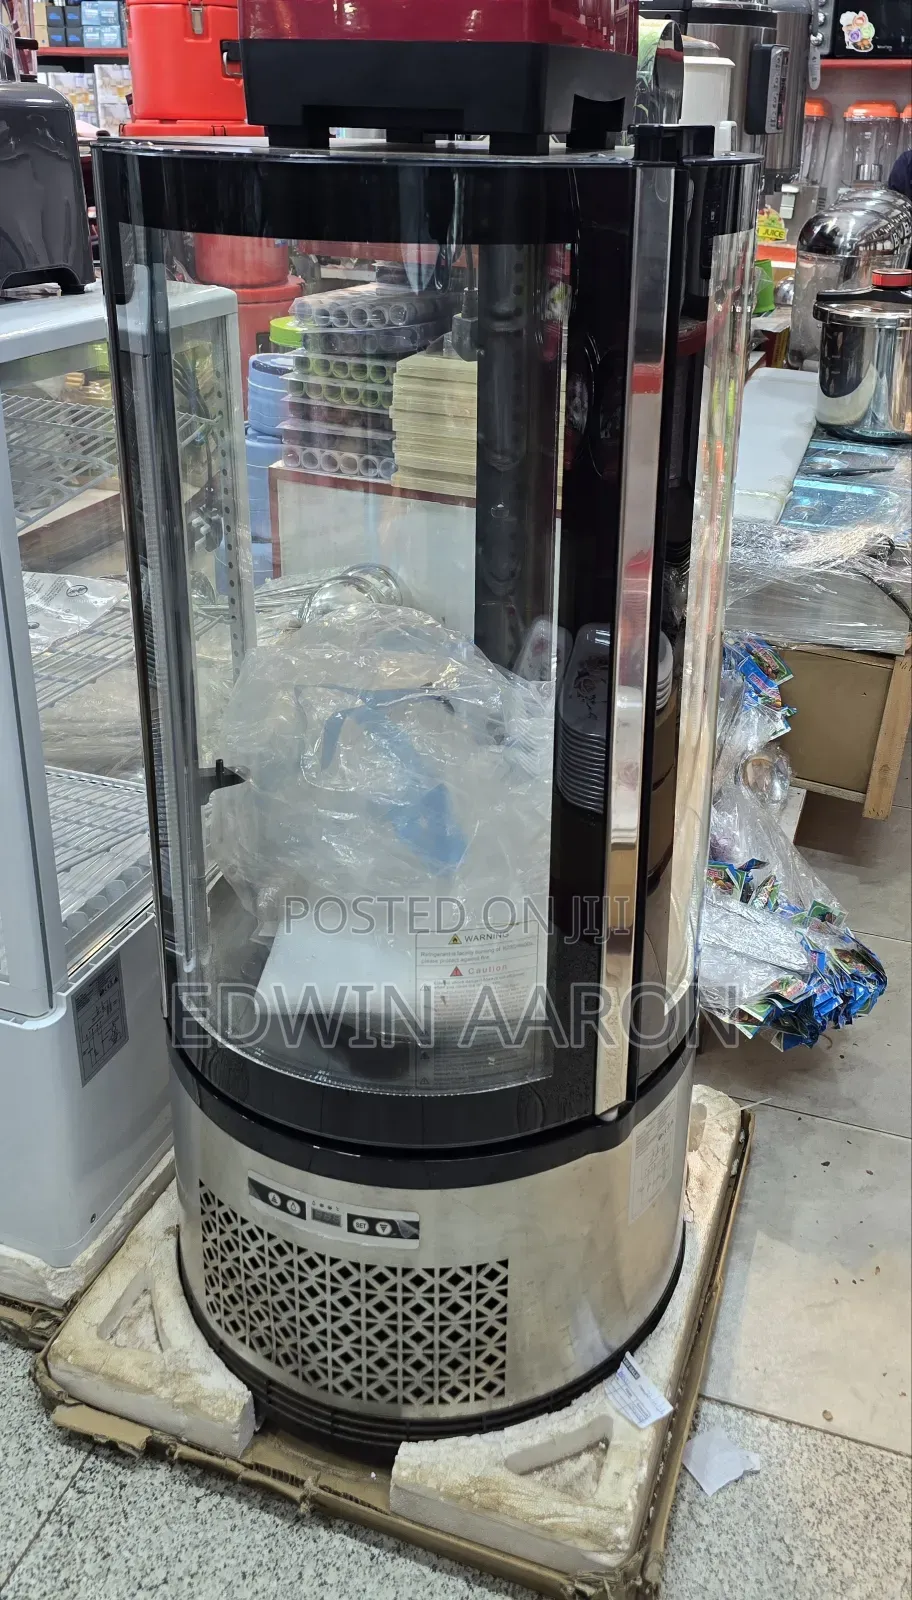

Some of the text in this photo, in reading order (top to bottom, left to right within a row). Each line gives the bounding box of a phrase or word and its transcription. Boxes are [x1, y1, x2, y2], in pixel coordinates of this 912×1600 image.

[763, 229, 785, 239] JUICE
[464, 932, 510, 943] WARNING
[468, 964, 508, 975] Caution
[355, 1221, 367, 1229] SET
